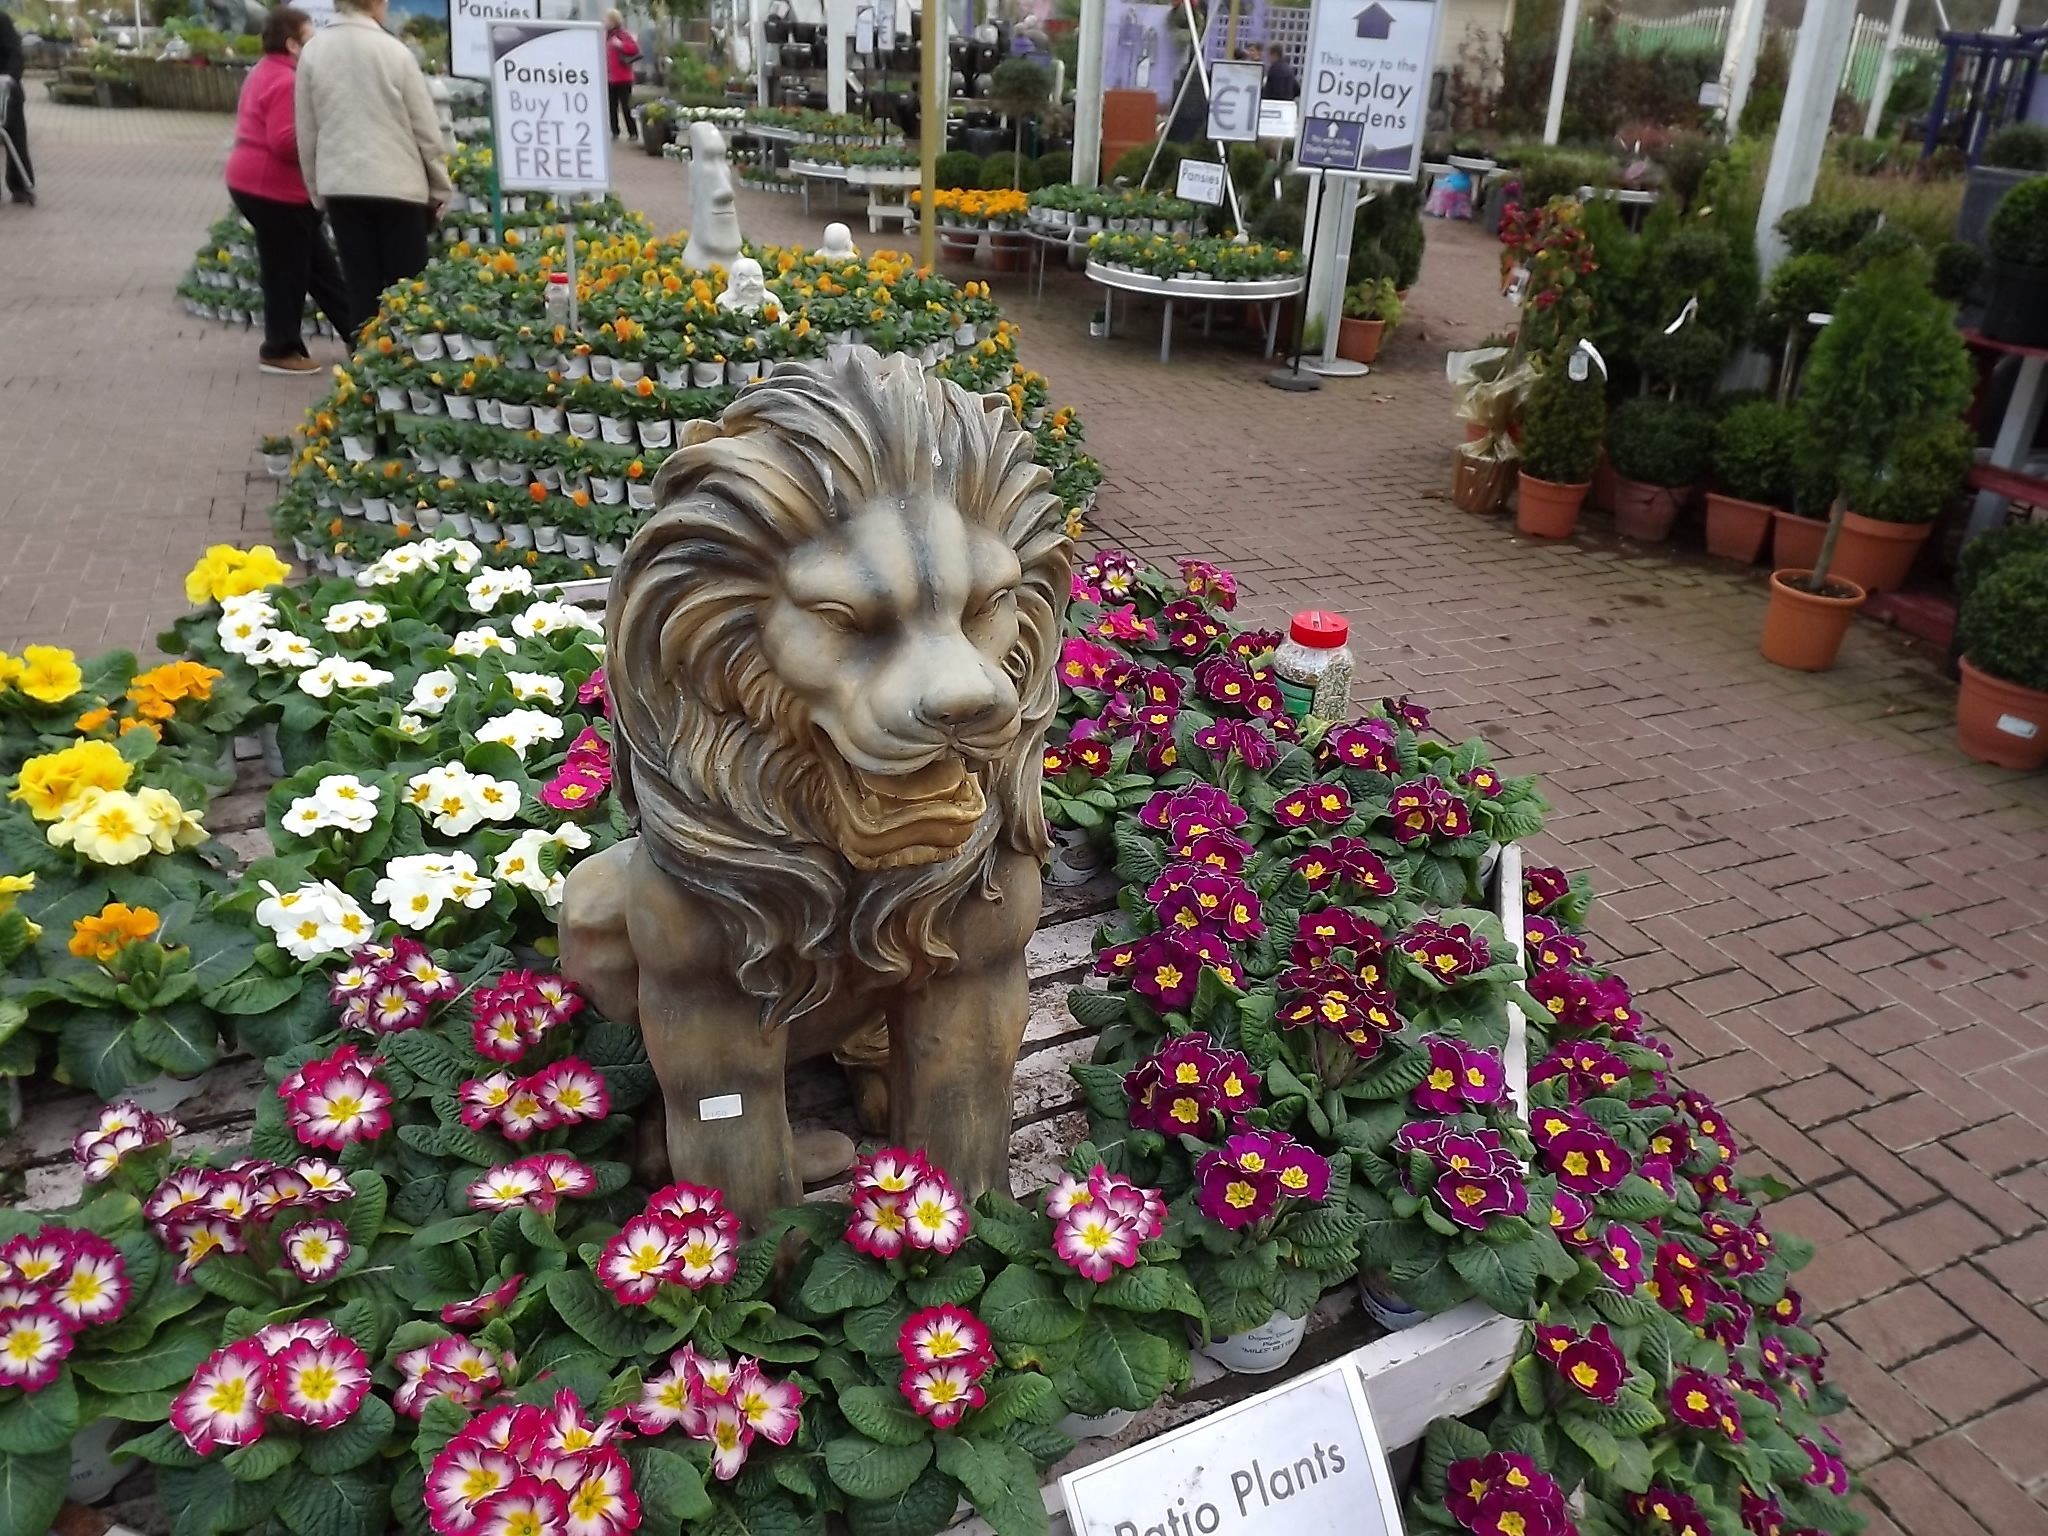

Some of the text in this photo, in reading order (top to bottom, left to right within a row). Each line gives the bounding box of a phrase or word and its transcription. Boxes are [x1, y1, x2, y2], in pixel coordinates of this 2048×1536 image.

[458, 0, 530, 18] Pansies
[503, 59, 589, 84] Pansies
[1320, 51, 1417, 72] This way to the
[1318, 69, 1413, 109] Display
[509, 90, 588, 119] Buy 10
[1210, 83, 1258, 132] €1
[1312, 101, 1406, 129] Gardens
[511, 119, 591, 146] GET 2
[515, 147, 593, 178] FREE
[1181, 167, 1220, 185] Pansies
[1230, 1441, 1346, 1517] Plants
